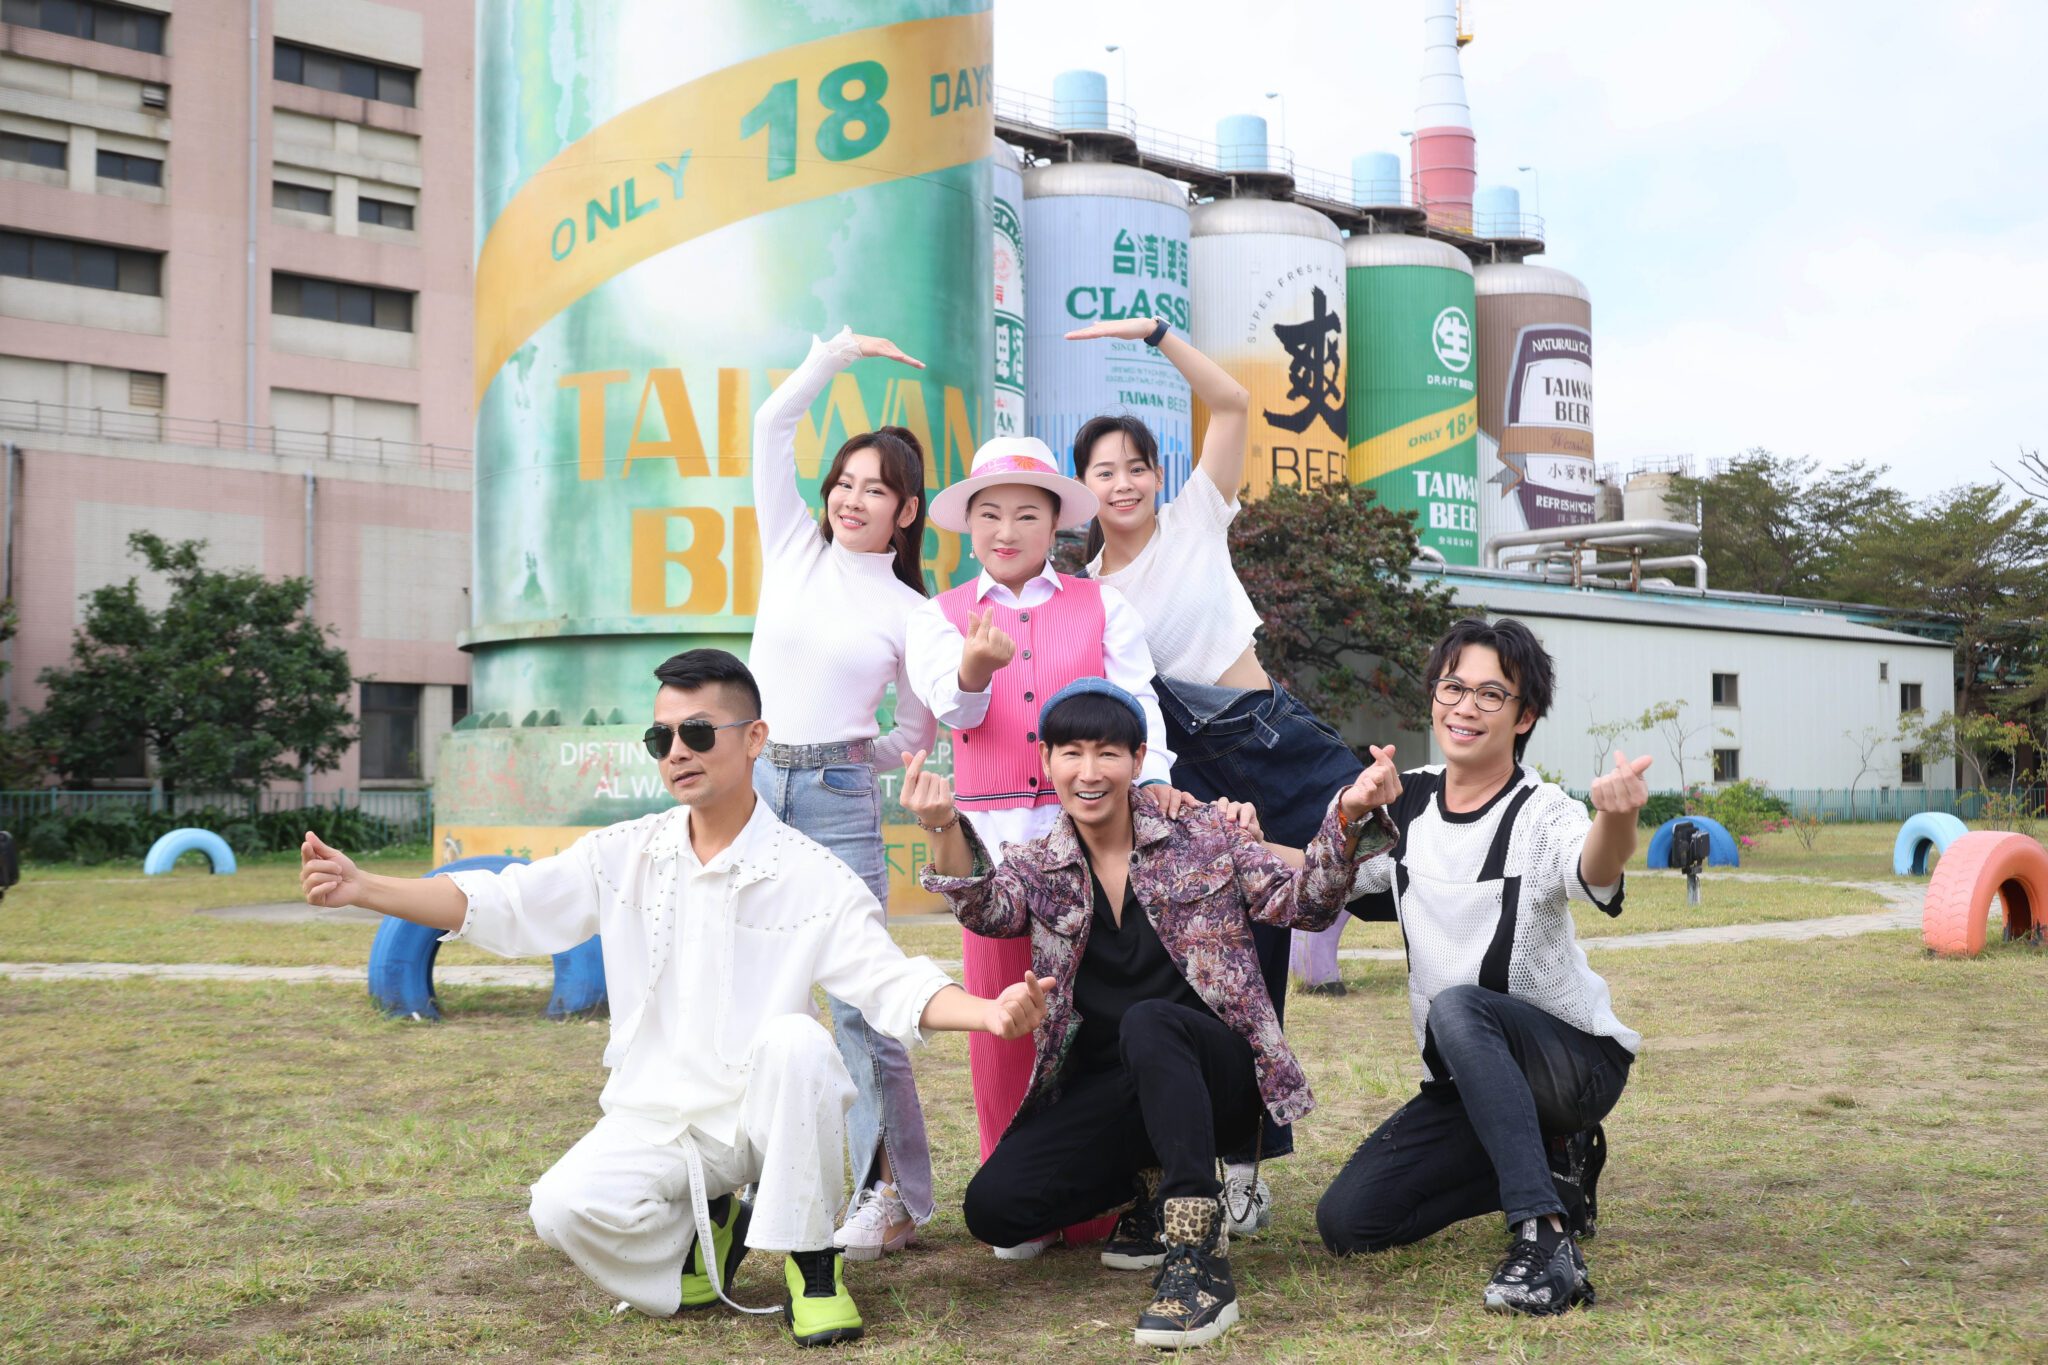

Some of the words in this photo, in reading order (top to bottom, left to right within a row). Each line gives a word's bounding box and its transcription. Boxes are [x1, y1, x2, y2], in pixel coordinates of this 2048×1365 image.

[551, 149, 692, 261] ONLY
[740, 60, 890, 182] 18
[1247, 291, 1275, 344] SUPER
[1278, 264, 1321, 287] FRESH
[1437, 316, 1468, 361] 生
[1427, 375, 1458, 387] DRAFT
[1118, 390, 1164, 407] TAIWAN
[1555, 400, 1591, 427] BEER
[558, 367, 983, 490] TAIWAN
[1408, 428, 1441, 448] ONLY
[1446, 412, 1467, 441] 18
[1429, 502, 1477, 533] BEER
[1535, 494, 1587, 514] REFRESHING
